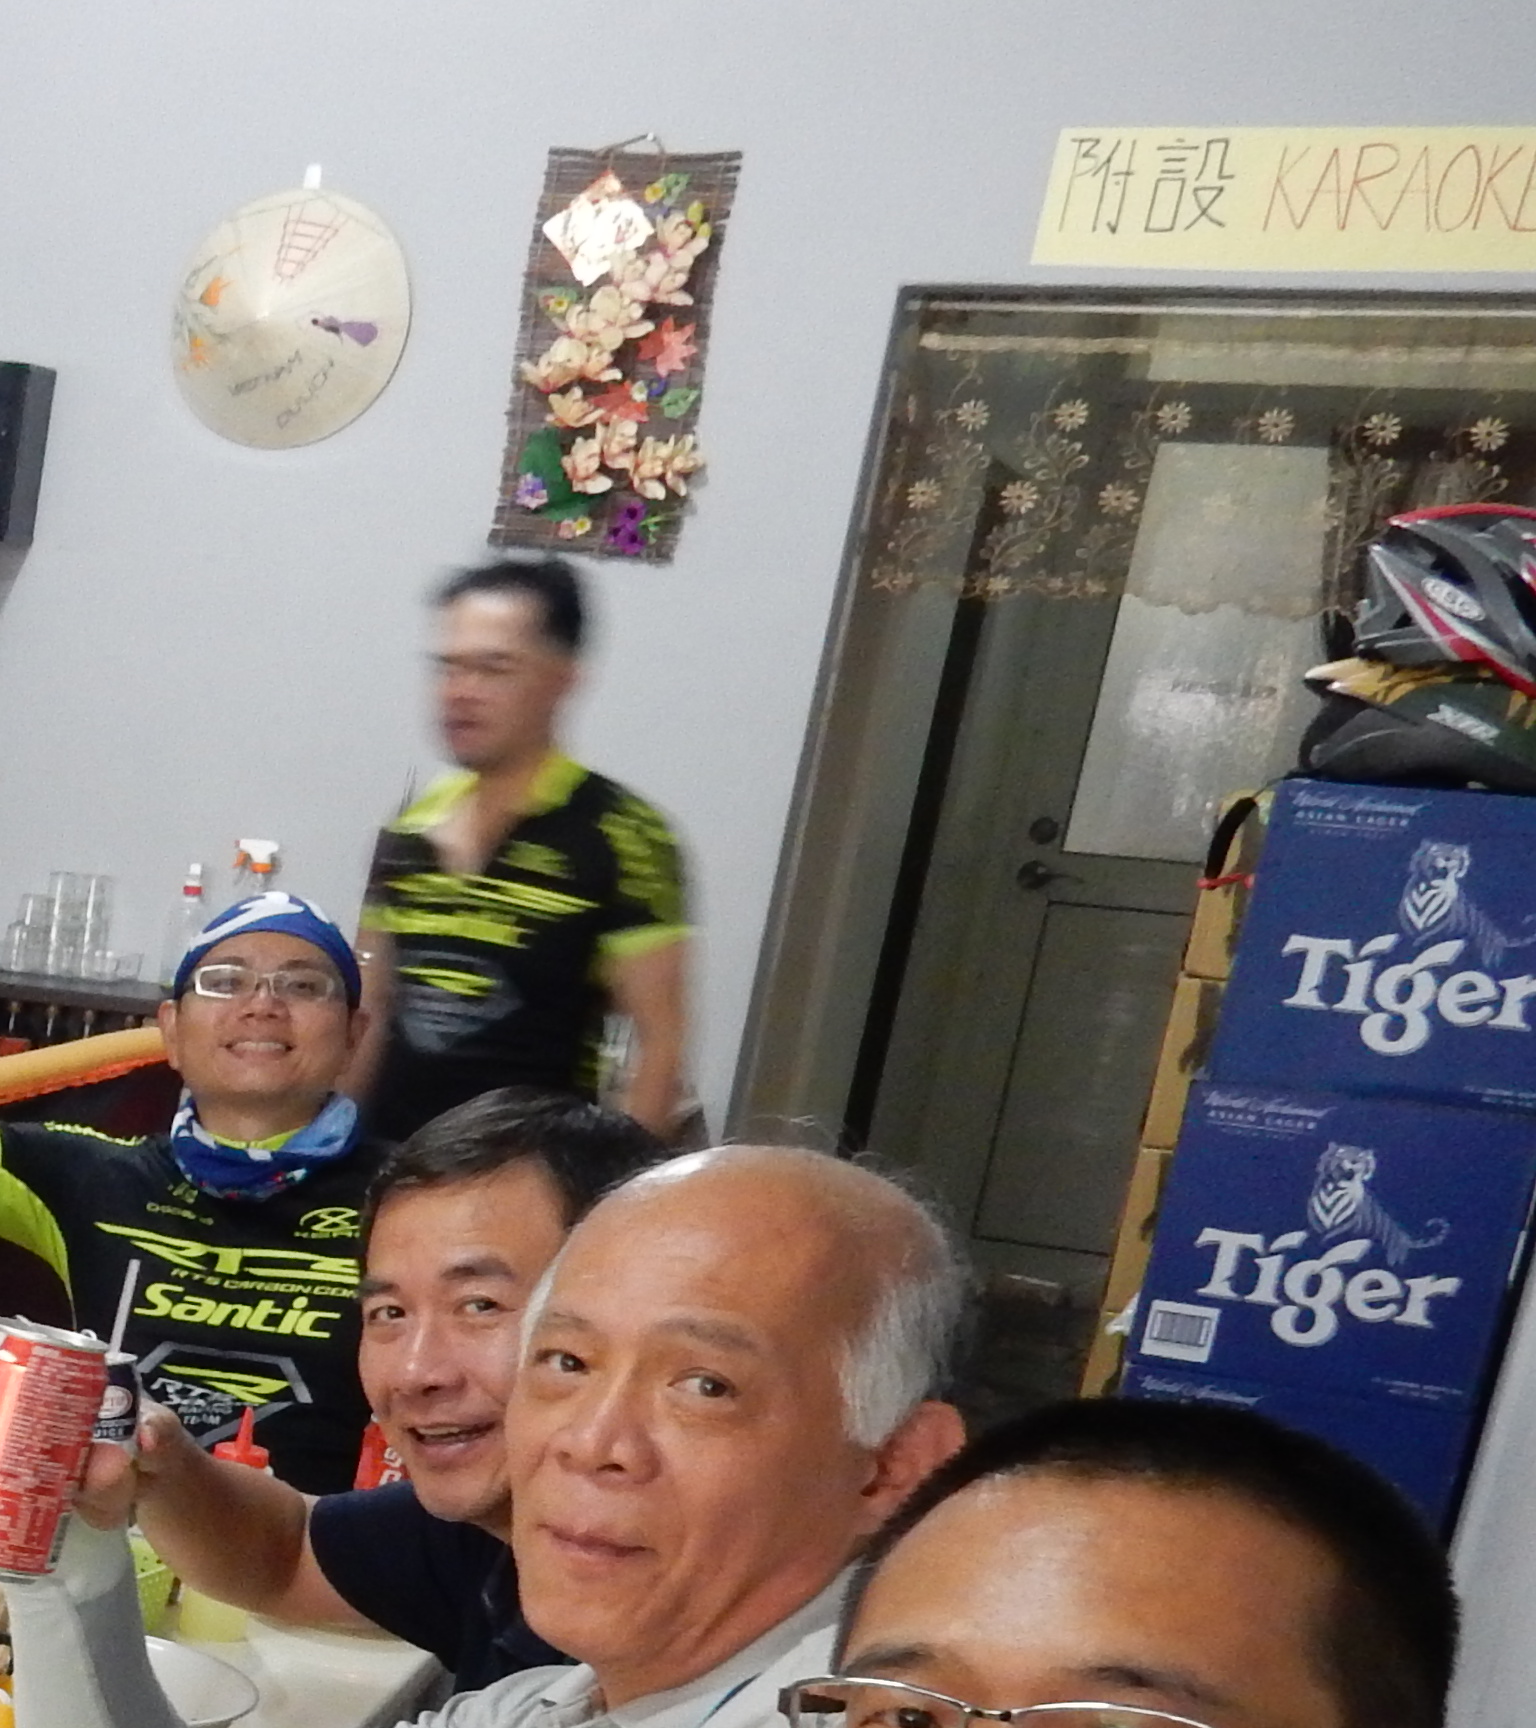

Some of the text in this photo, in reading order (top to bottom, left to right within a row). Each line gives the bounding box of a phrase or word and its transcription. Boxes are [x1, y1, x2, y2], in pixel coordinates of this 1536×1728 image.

[1059, 138, 1235, 234] 附設
[1280, 932, 1536, 1057] Tiger
[134, 1282, 341, 1338] Santic
[1193, 1226, 1463, 1348] Tiger
